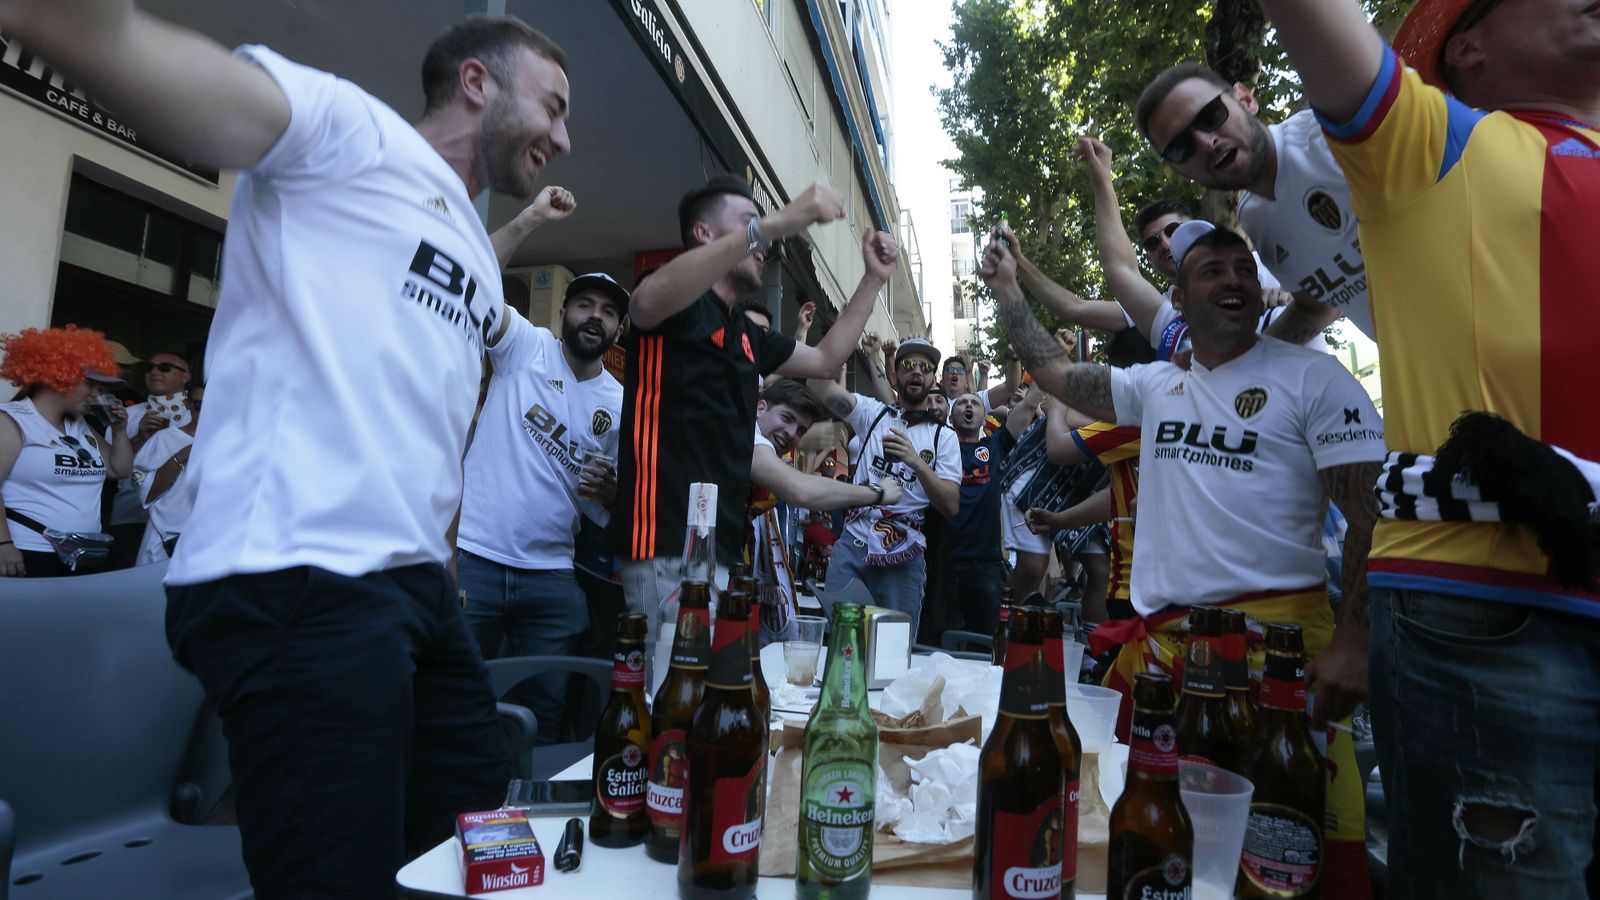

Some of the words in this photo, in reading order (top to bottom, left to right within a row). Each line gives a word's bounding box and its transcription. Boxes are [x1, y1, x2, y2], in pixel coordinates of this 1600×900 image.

[630, 0, 672, 64] Galicia
[46, 90, 89, 119] CAFÉ
[92, 112, 103, 126] &
[107, 118, 137, 142] BAR
[521, 420, 582, 476] smartphone
[1155, 420, 1259, 455] BLU
[871, 455, 917, 482] BLU
[1154, 446, 1254, 473] smartphones
[606, 767, 648, 783] Estrell
[648, 786, 684, 809] ruzca
[806, 803, 874, 826] Heineken
[811, 838, 842, 868] PREMIUM
[844, 839, 869, 867] QUALITY
[481, 872, 529, 891] Winston
